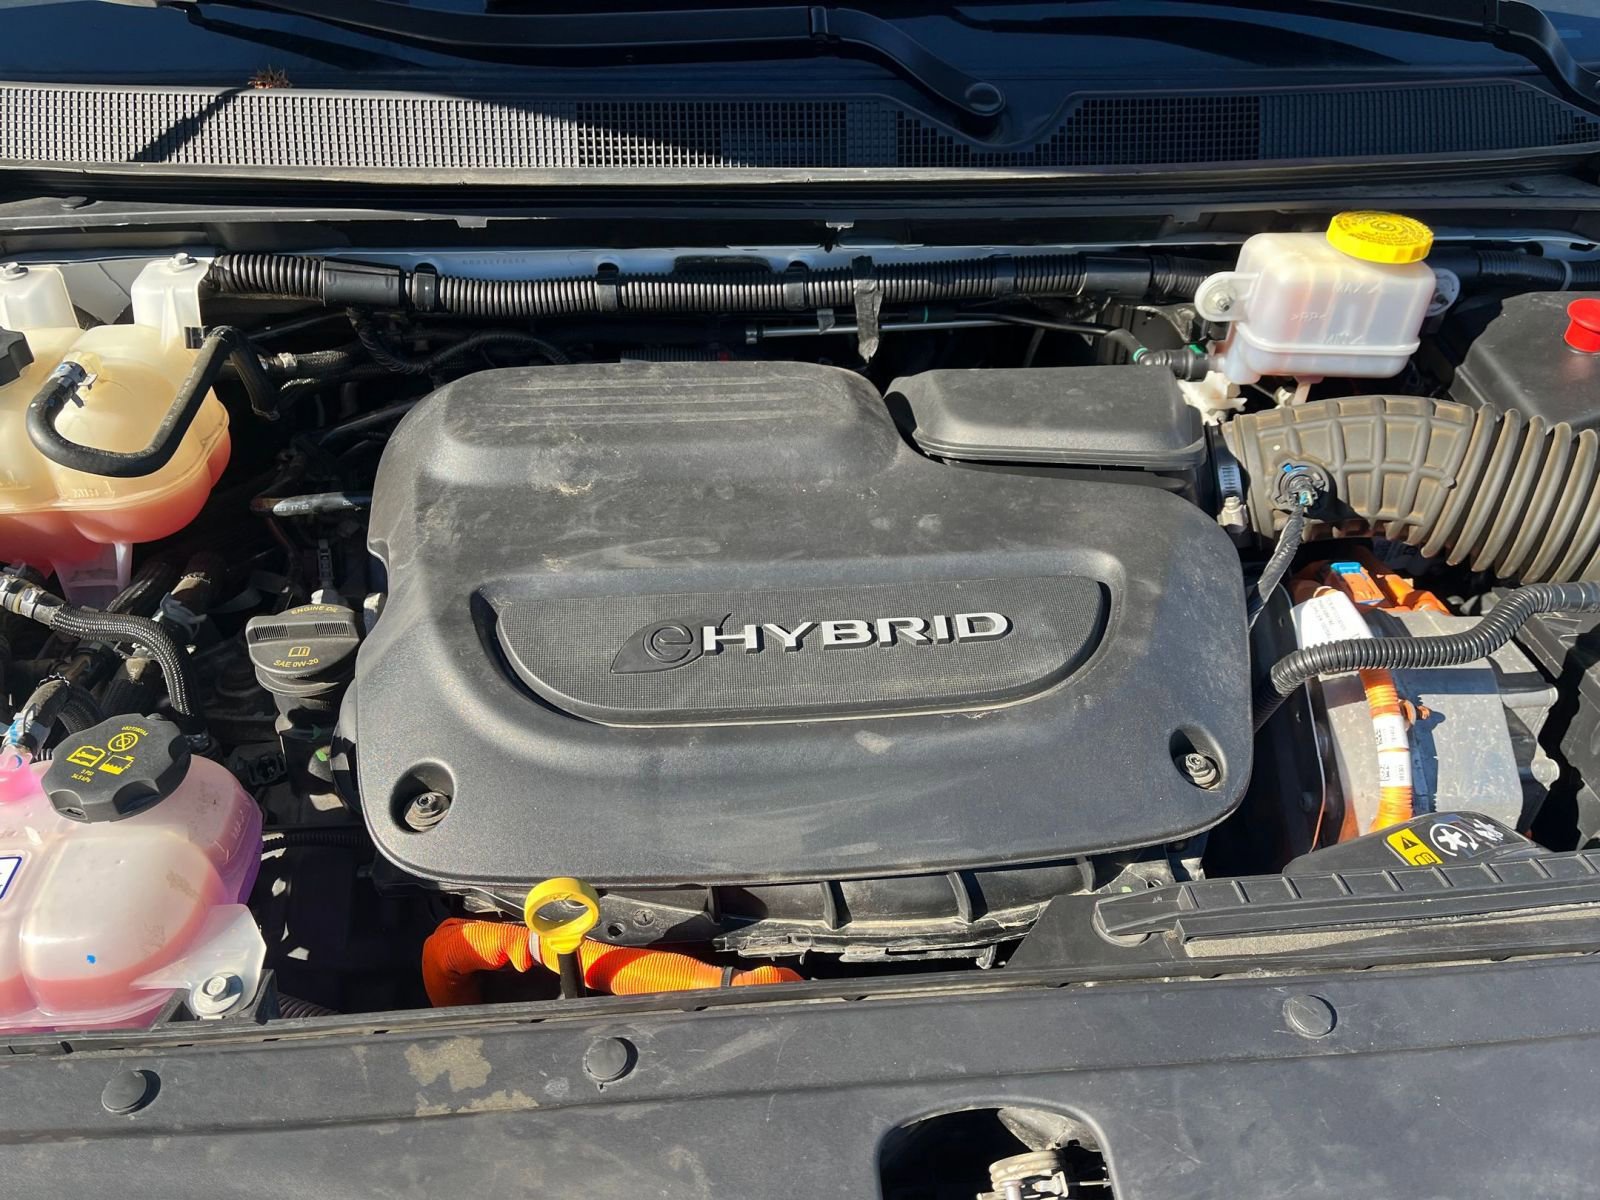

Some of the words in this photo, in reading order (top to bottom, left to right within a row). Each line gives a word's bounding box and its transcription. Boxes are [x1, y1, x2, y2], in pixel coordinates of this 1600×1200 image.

[290, 605, 325, 616] ENGINE
[273, 659, 292, 668] SAE
[292, 657, 319, 668] 0W-20
